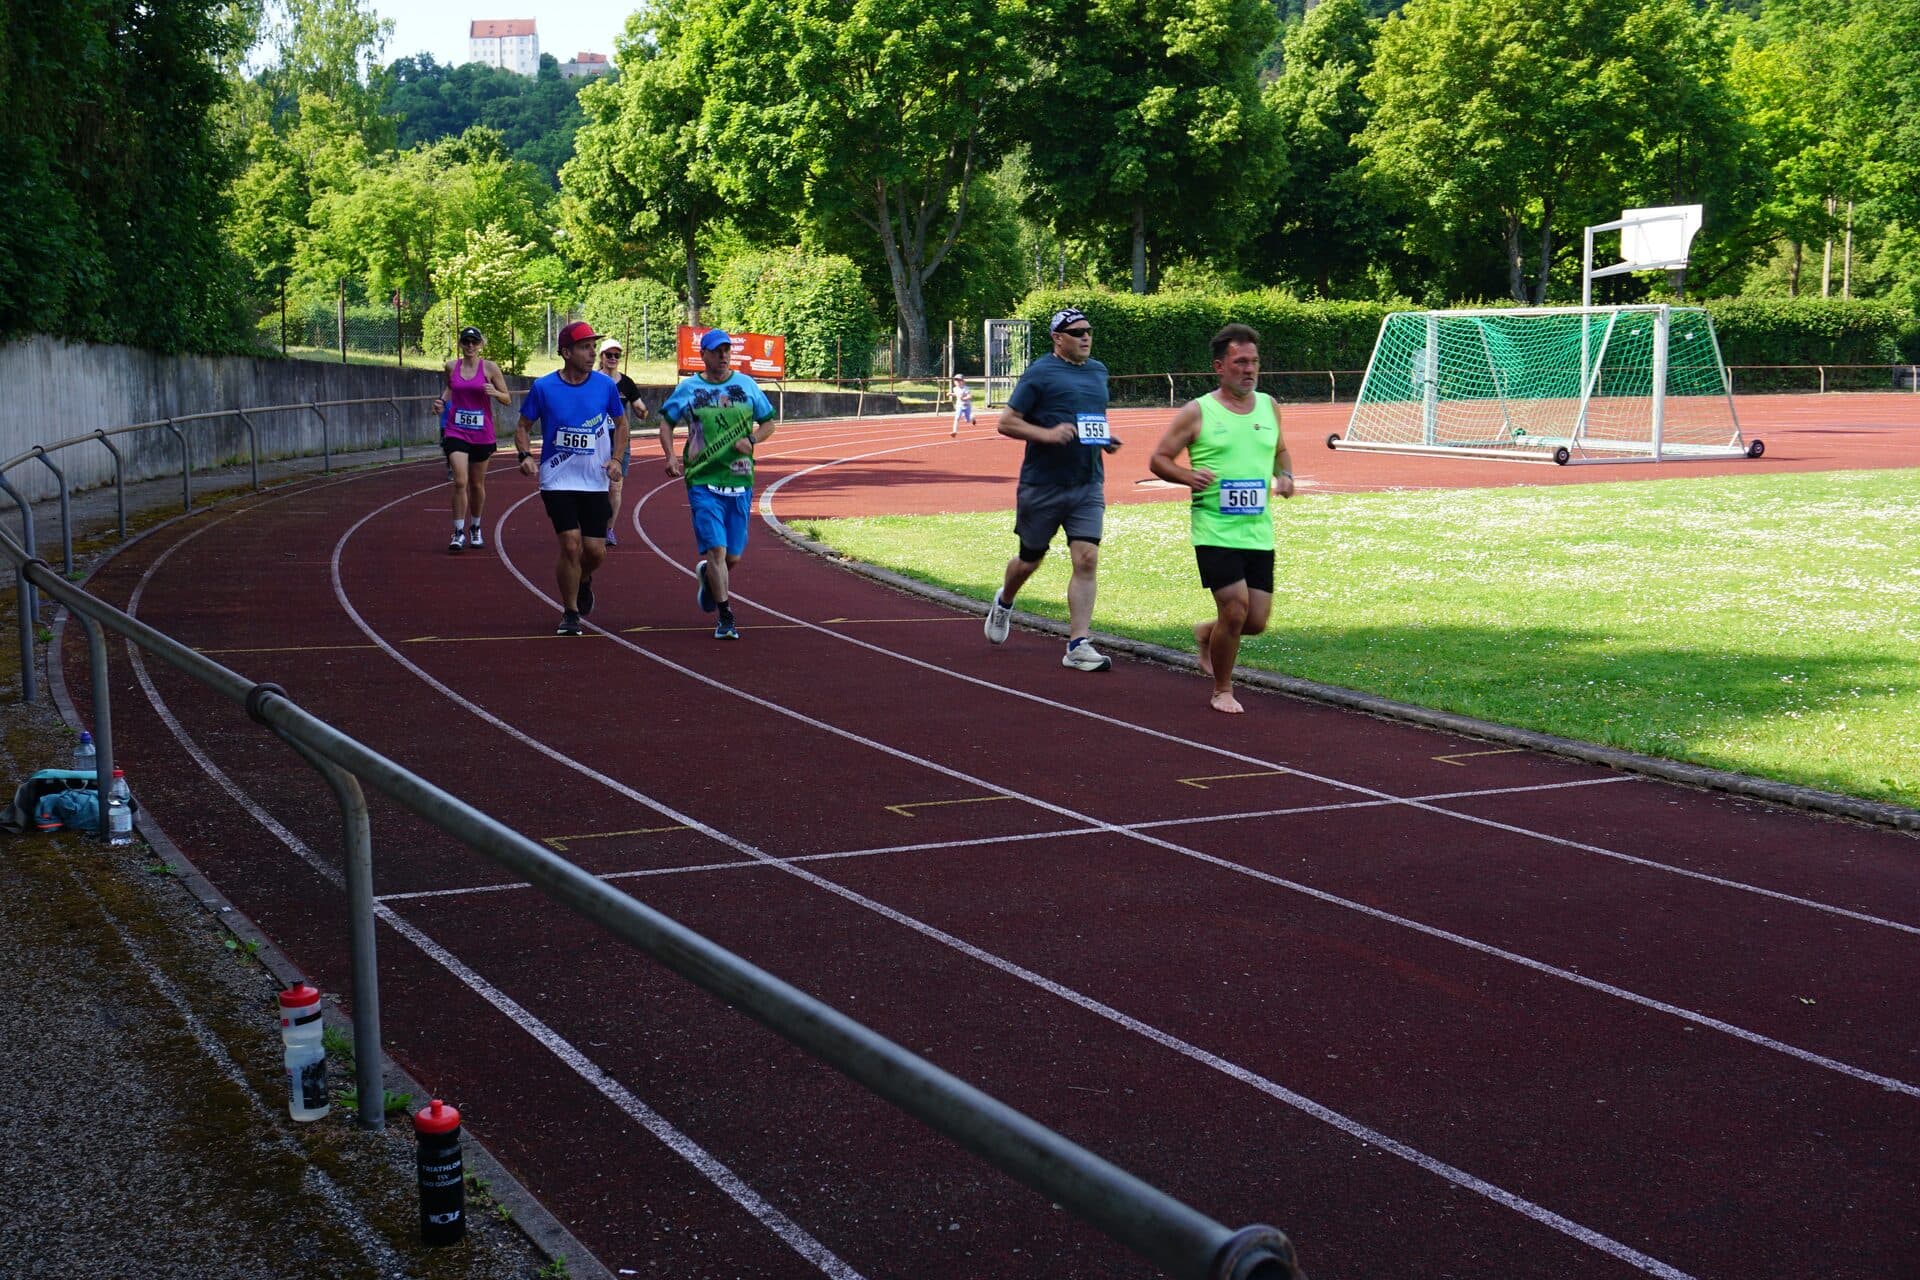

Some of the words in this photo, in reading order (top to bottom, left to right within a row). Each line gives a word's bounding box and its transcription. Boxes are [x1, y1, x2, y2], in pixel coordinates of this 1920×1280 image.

[460, 414, 478, 425] 564
[1085, 423, 1104, 437] 559
[563, 433, 588, 448] 566
[1228, 489, 1258, 507] 560
[429, 1210, 461, 1224] WOLF
